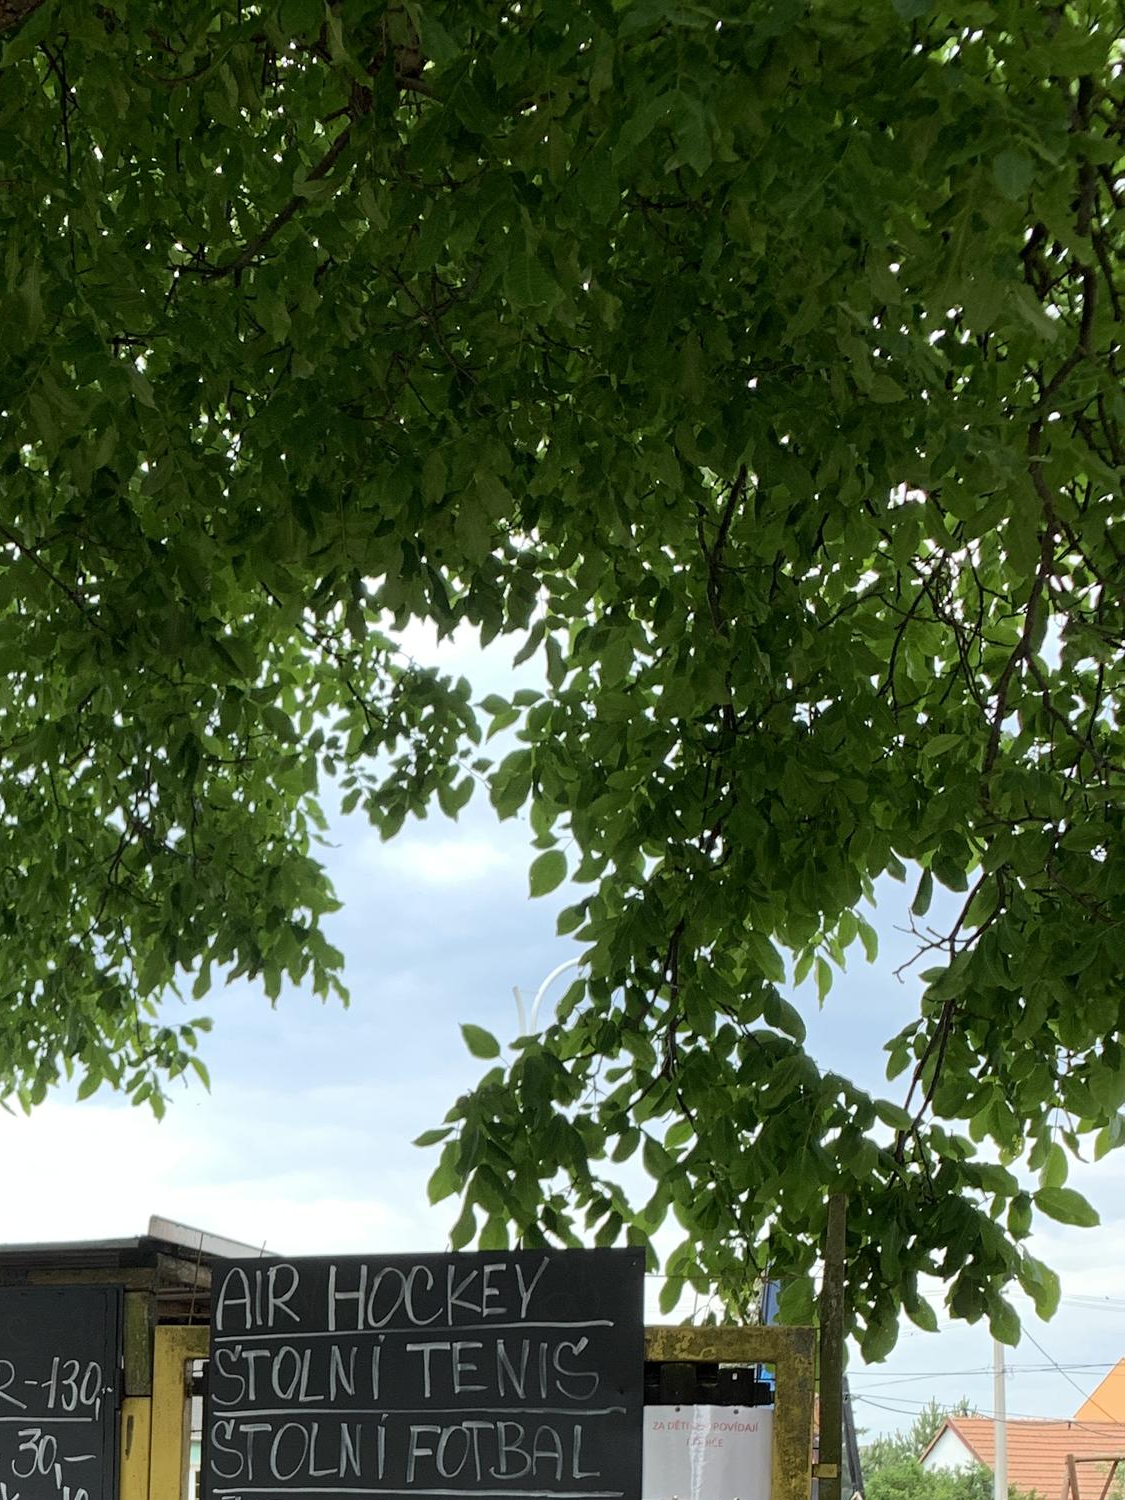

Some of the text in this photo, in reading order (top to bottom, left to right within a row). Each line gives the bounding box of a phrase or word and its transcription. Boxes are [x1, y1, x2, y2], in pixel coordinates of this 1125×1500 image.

[216, 1256, 550, 1331] AIR HOCKEY
[211, 1335, 600, 1406] STOLNÍ TENIS
[211, 1413, 601, 1483] STOLNÍ FOTBAL
